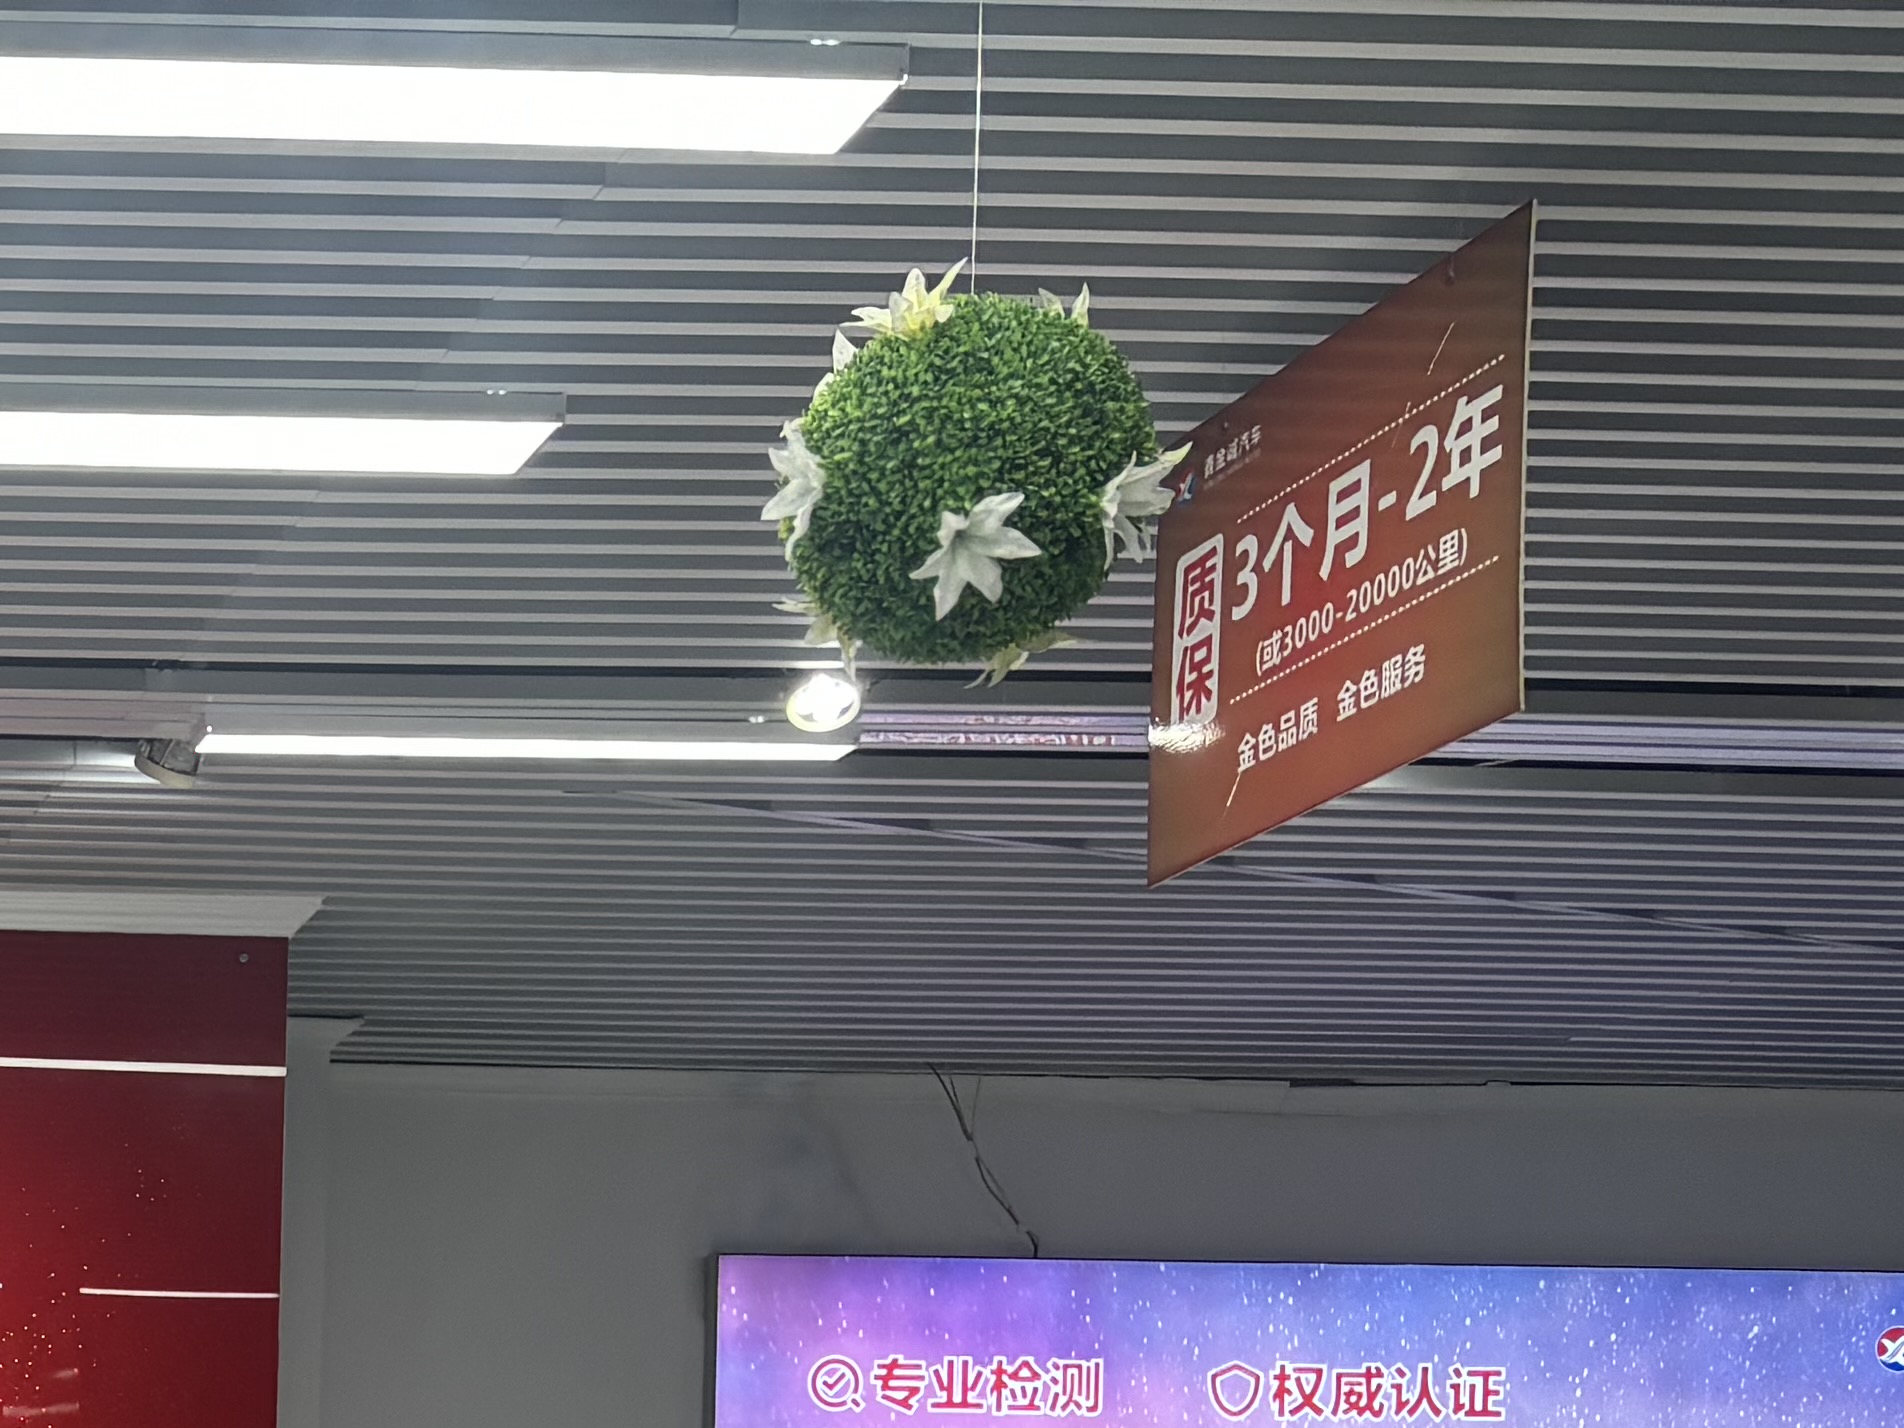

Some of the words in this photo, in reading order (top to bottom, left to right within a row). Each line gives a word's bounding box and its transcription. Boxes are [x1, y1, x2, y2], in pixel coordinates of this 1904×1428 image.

[1231, 383, 1504, 622] 3个月-2年
[1176, 552, 1218, 720] 质保
[1255, 527, 1468, 677] (或3000-20000公里)
[1237, 695, 1319, 774] 金色品质
[1335, 644, 1426, 723] 金色服务
[870, 1356, 1104, 1418] 专业检测
[1270, 1360, 1507, 1423] 权威认证
